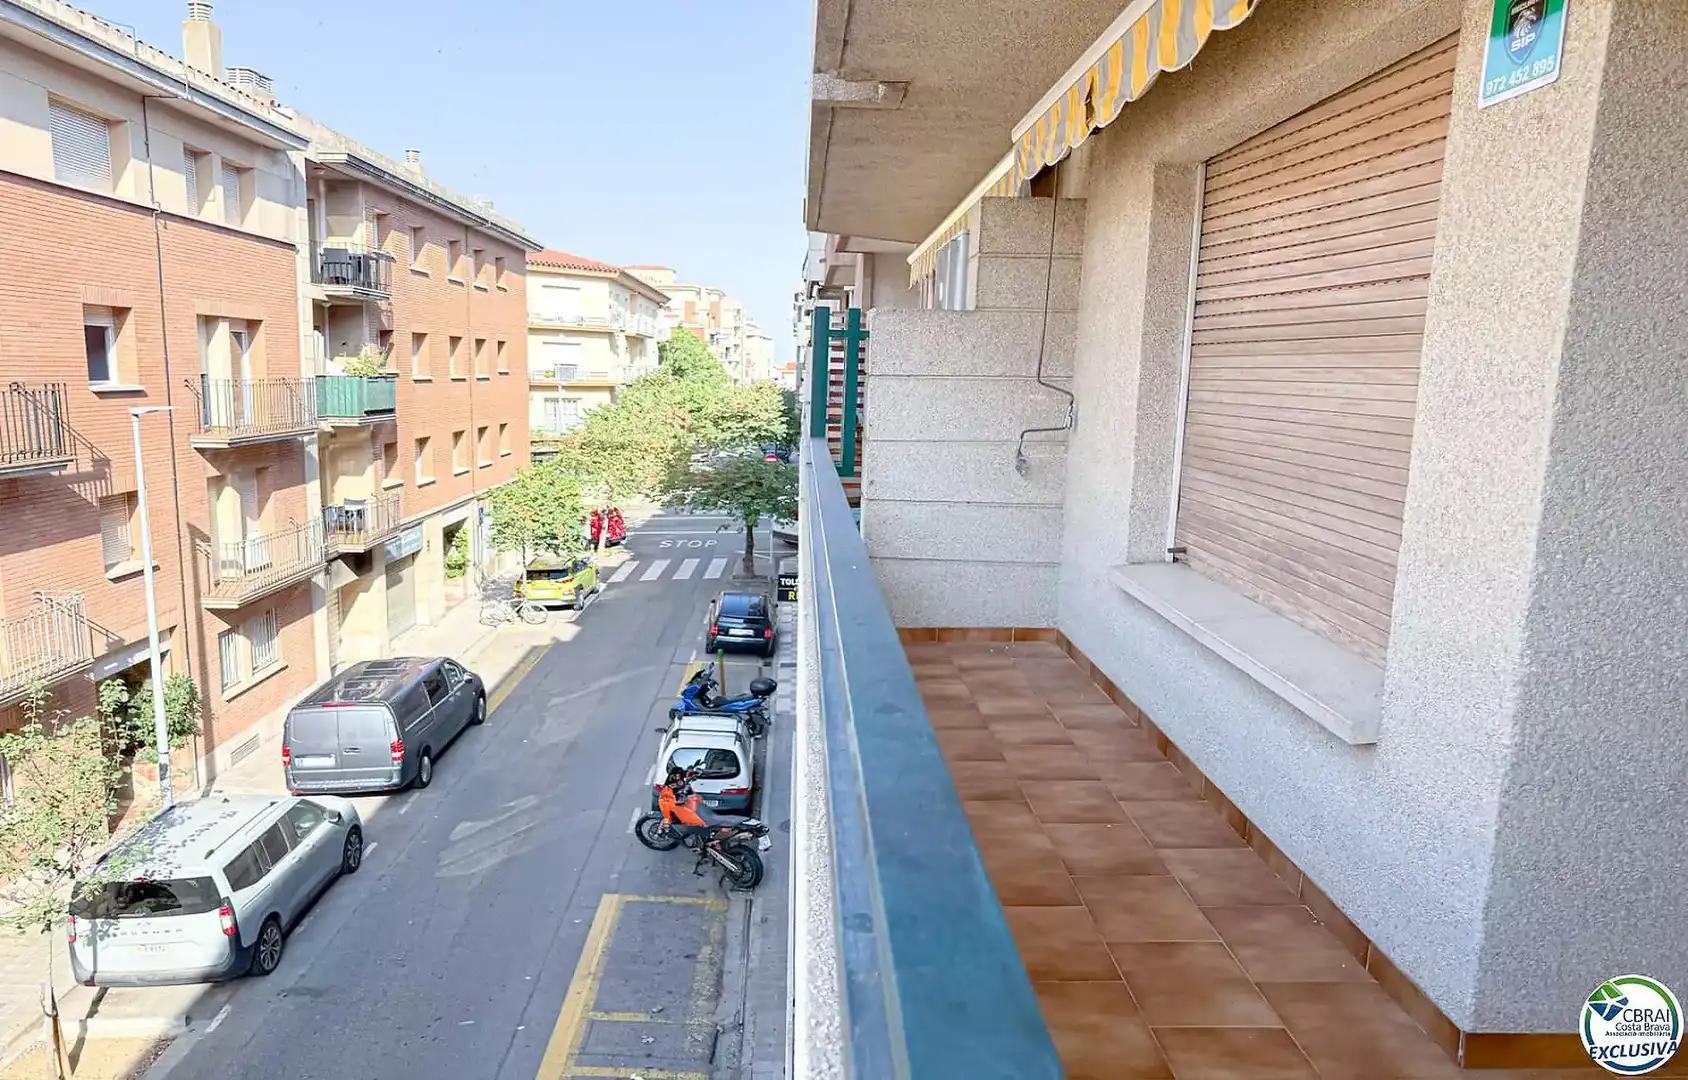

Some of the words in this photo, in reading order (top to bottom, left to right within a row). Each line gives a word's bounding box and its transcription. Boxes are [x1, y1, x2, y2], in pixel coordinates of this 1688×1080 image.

[1511, 32, 1536, 52] SIP
[1485, 75, 1506, 96] 972
[1508, 65, 1530, 86] 452
[659, 539, 718, 548] STOP
